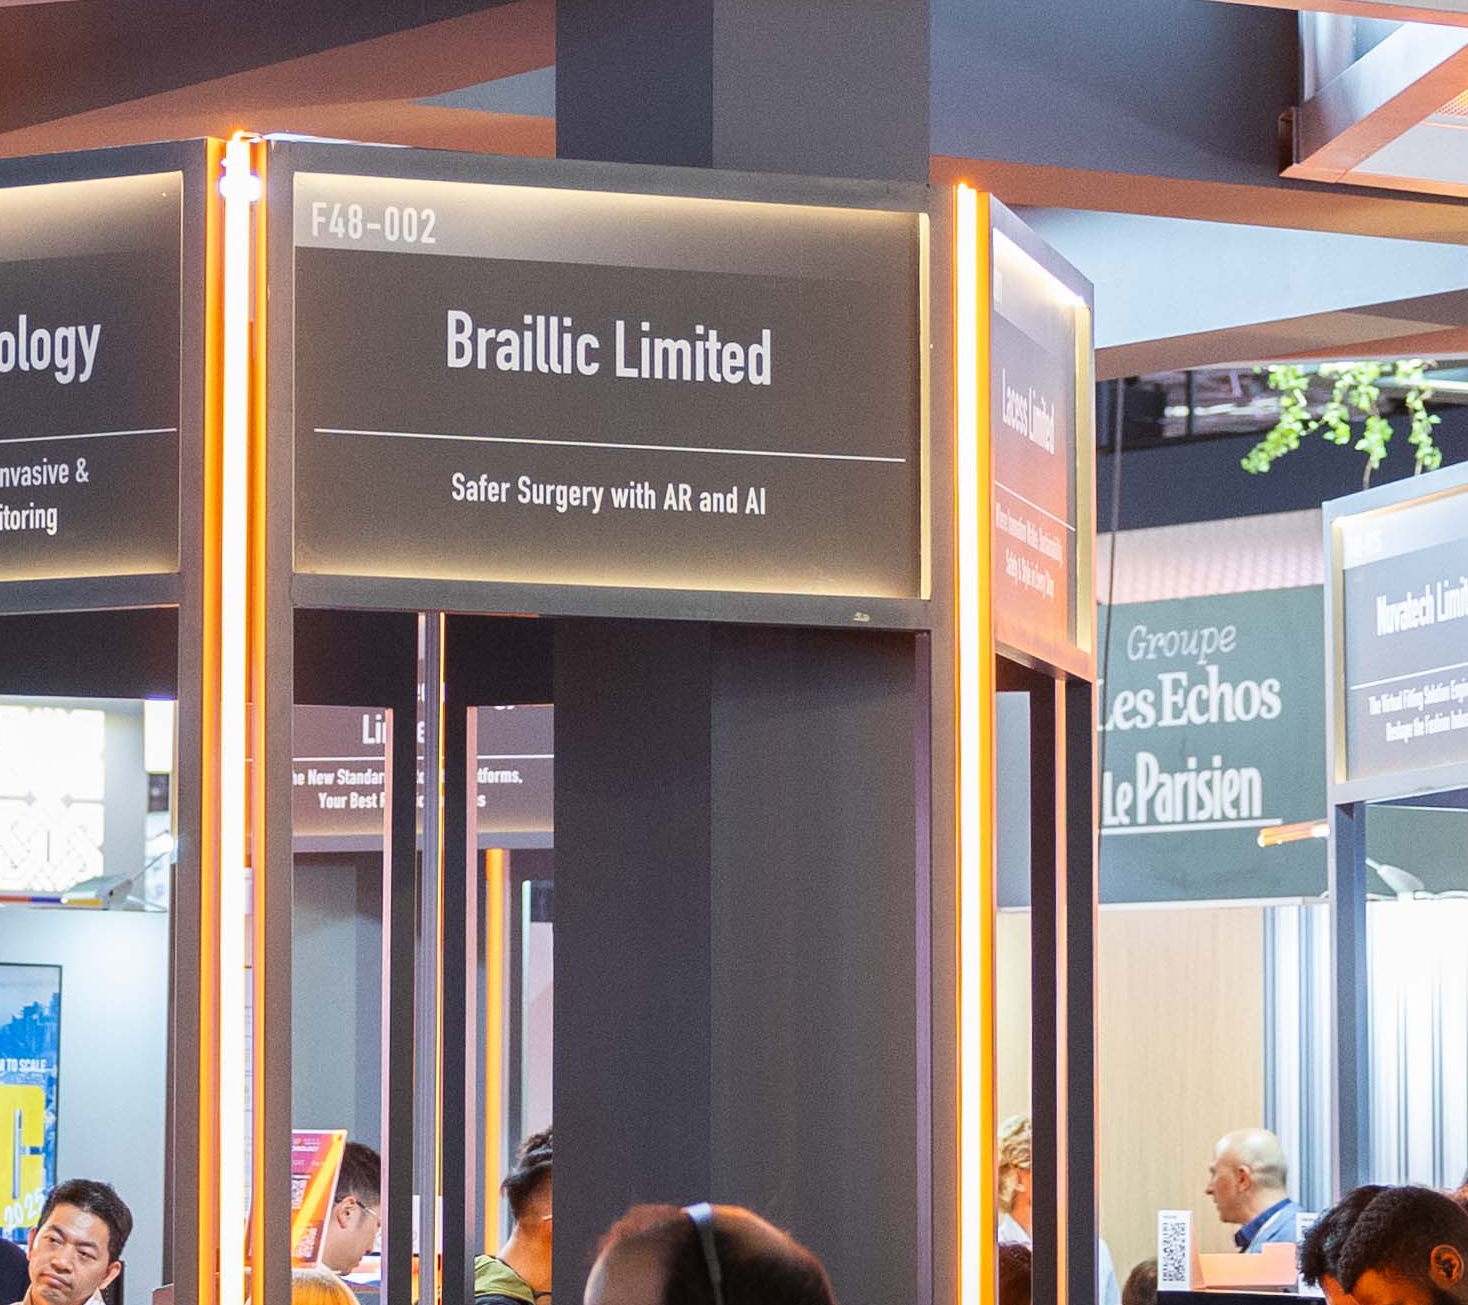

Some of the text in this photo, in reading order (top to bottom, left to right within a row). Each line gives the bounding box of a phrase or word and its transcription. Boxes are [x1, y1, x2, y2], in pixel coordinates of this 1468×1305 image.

[311, 201, 437, 244] F48-002
[447, 310, 772, 387] Braillic Limited
[75, 458, 89, 484] &
[451, 472, 766, 516] Safer Surgery with AR and AI
[1128, 625, 1237, 665] Groupe
[1158, 666, 1282, 726] Echos
[308, 768, 385, 785] New Standar
[1136, 751, 1261, 823] Parisien
[319, 792, 377, 808] Your Best
[7, 1059, 17, 1072] TO
[18, 1059, 47, 1073] SCALE
